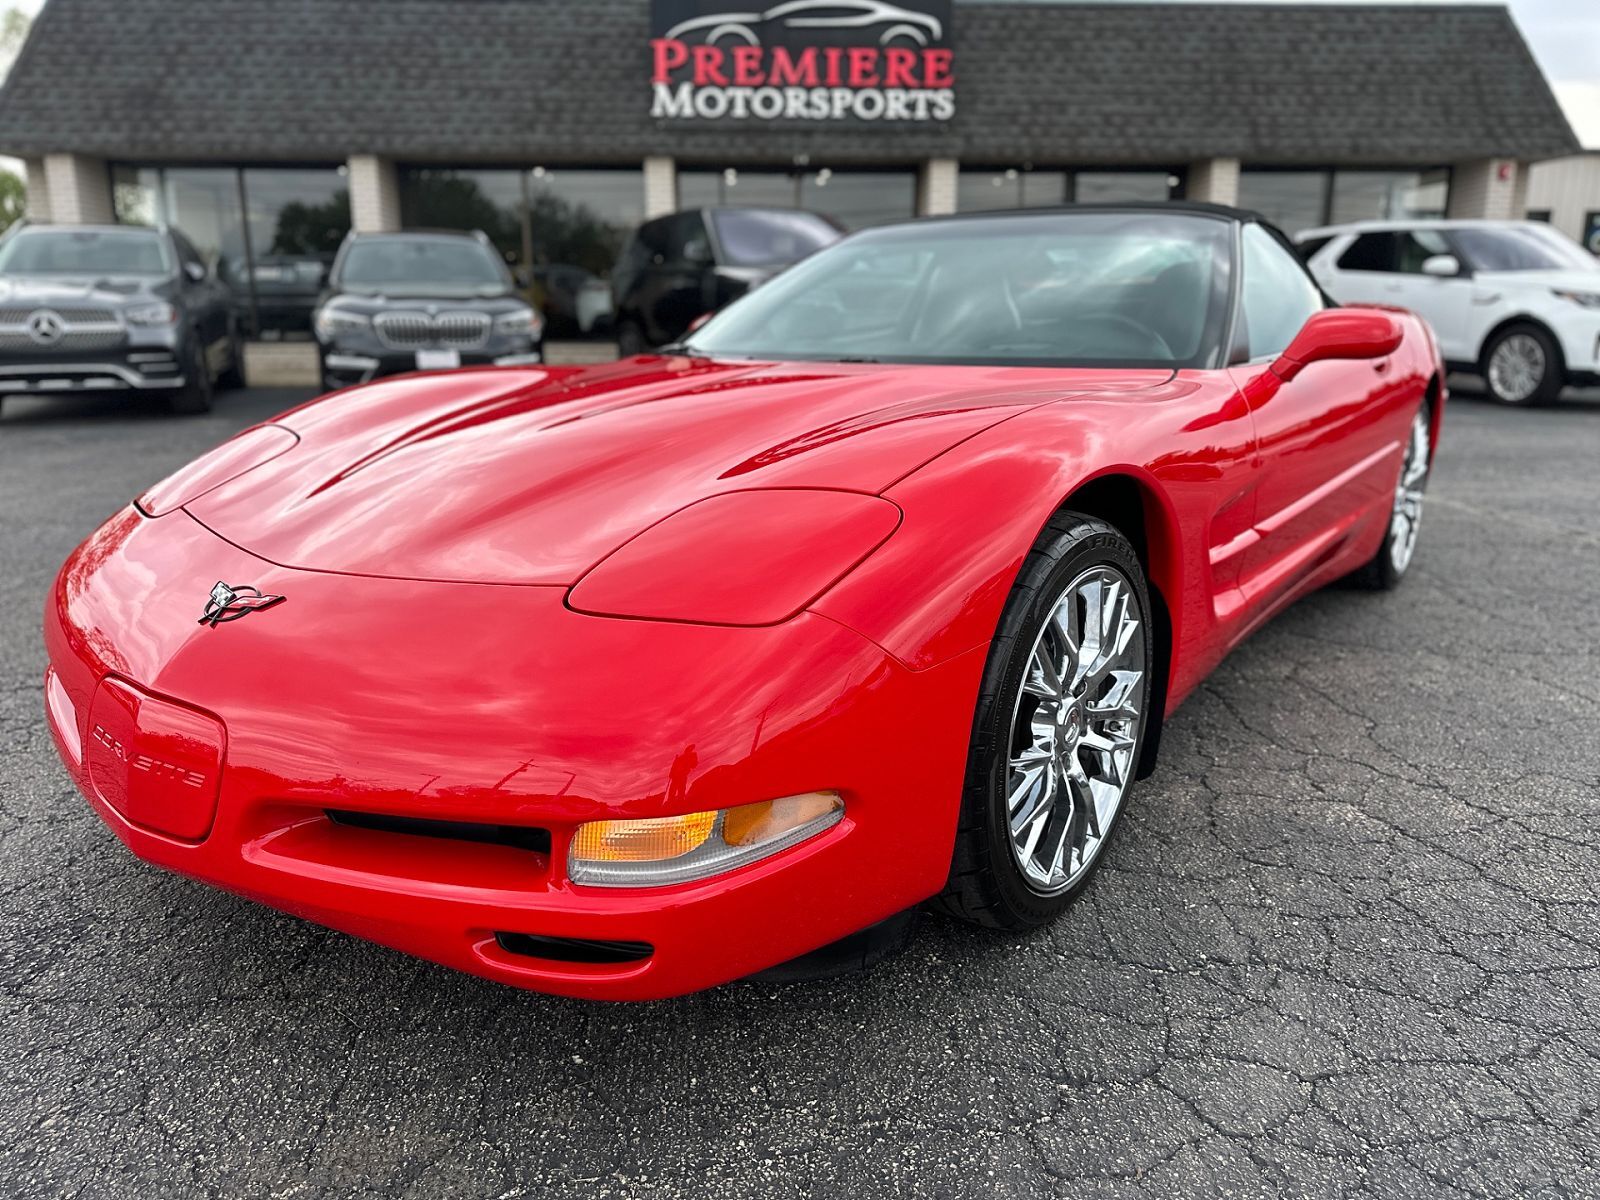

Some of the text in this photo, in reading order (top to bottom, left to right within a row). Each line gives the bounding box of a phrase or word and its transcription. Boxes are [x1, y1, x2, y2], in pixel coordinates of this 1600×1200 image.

[650, 38, 955, 88] PREMIERE
[650, 81, 955, 120] MOTORSPORTS
[92, 724, 206, 788] CORVETTE
